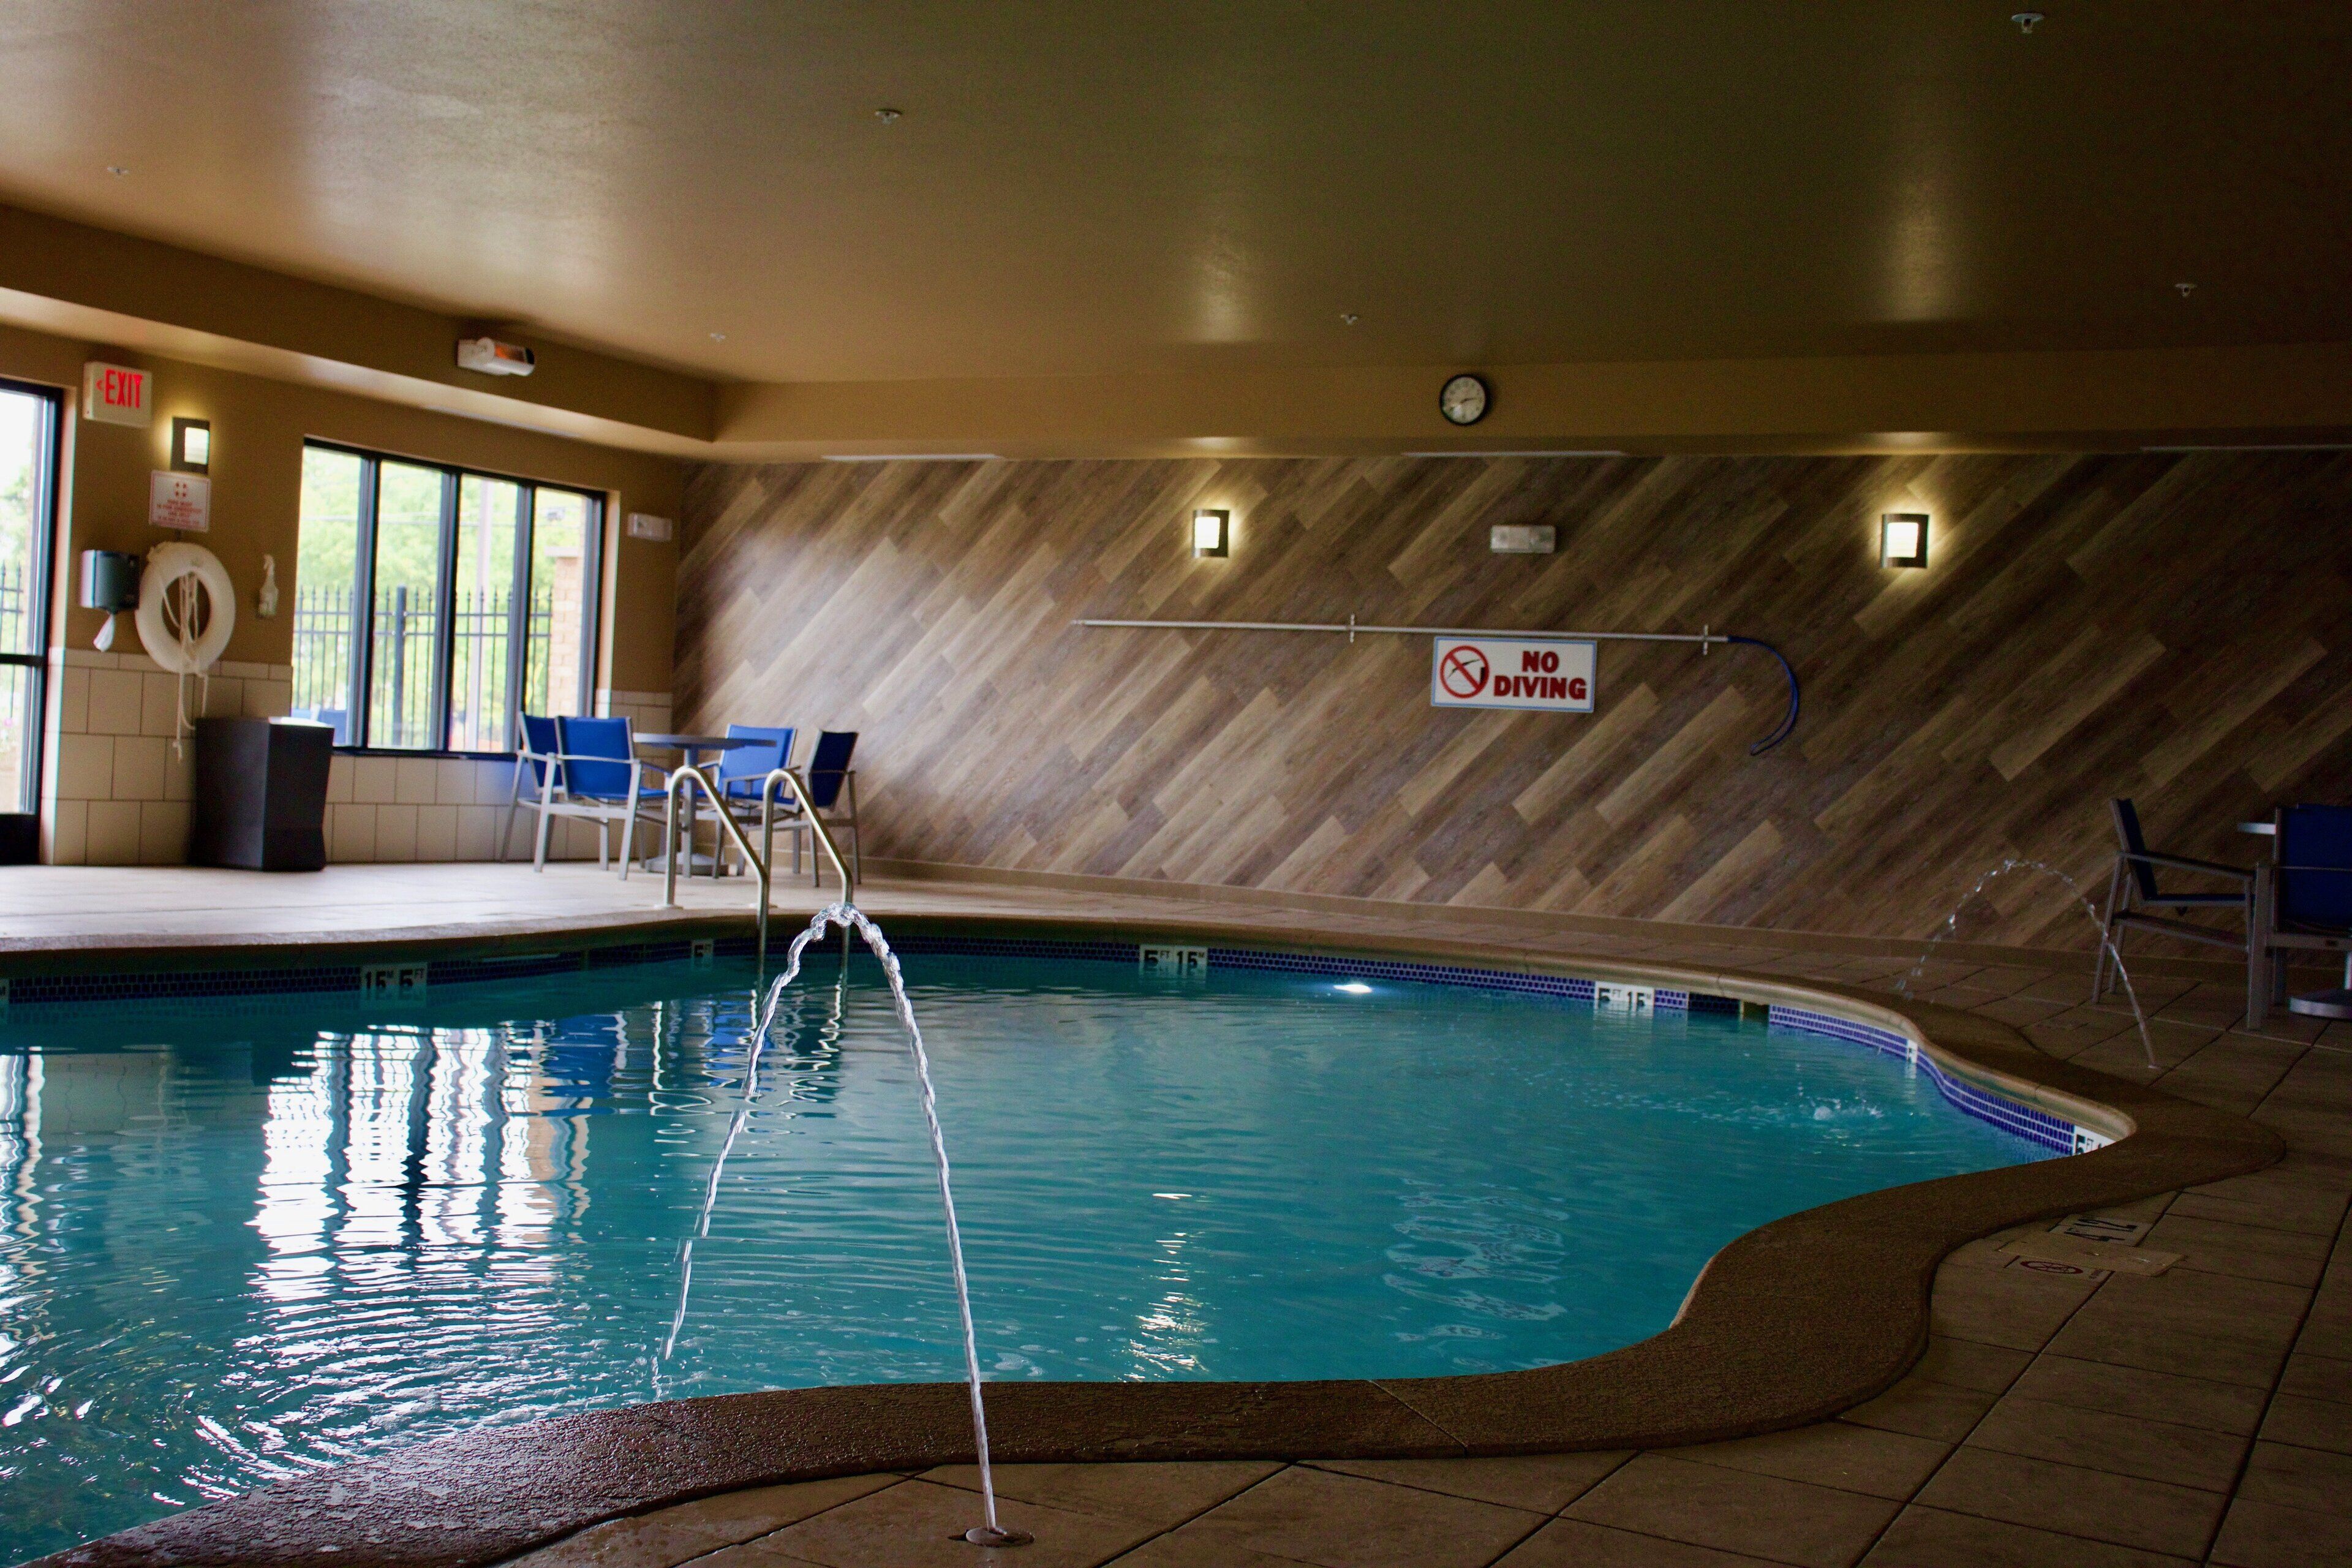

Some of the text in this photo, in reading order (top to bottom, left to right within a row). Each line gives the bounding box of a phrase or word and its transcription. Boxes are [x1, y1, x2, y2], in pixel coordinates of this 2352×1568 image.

[104, 368, 144, 409] EXIT
[1521, 650, 1559, 674] NO
[1493, 675, 1586, 701] DIVING
[1144, 949, 1158, 966] 5
[1160, 950, 1170, 959] FT
[1598, 987, 1610, 1002] 5
[1611, 989, 1622, 999] FT
